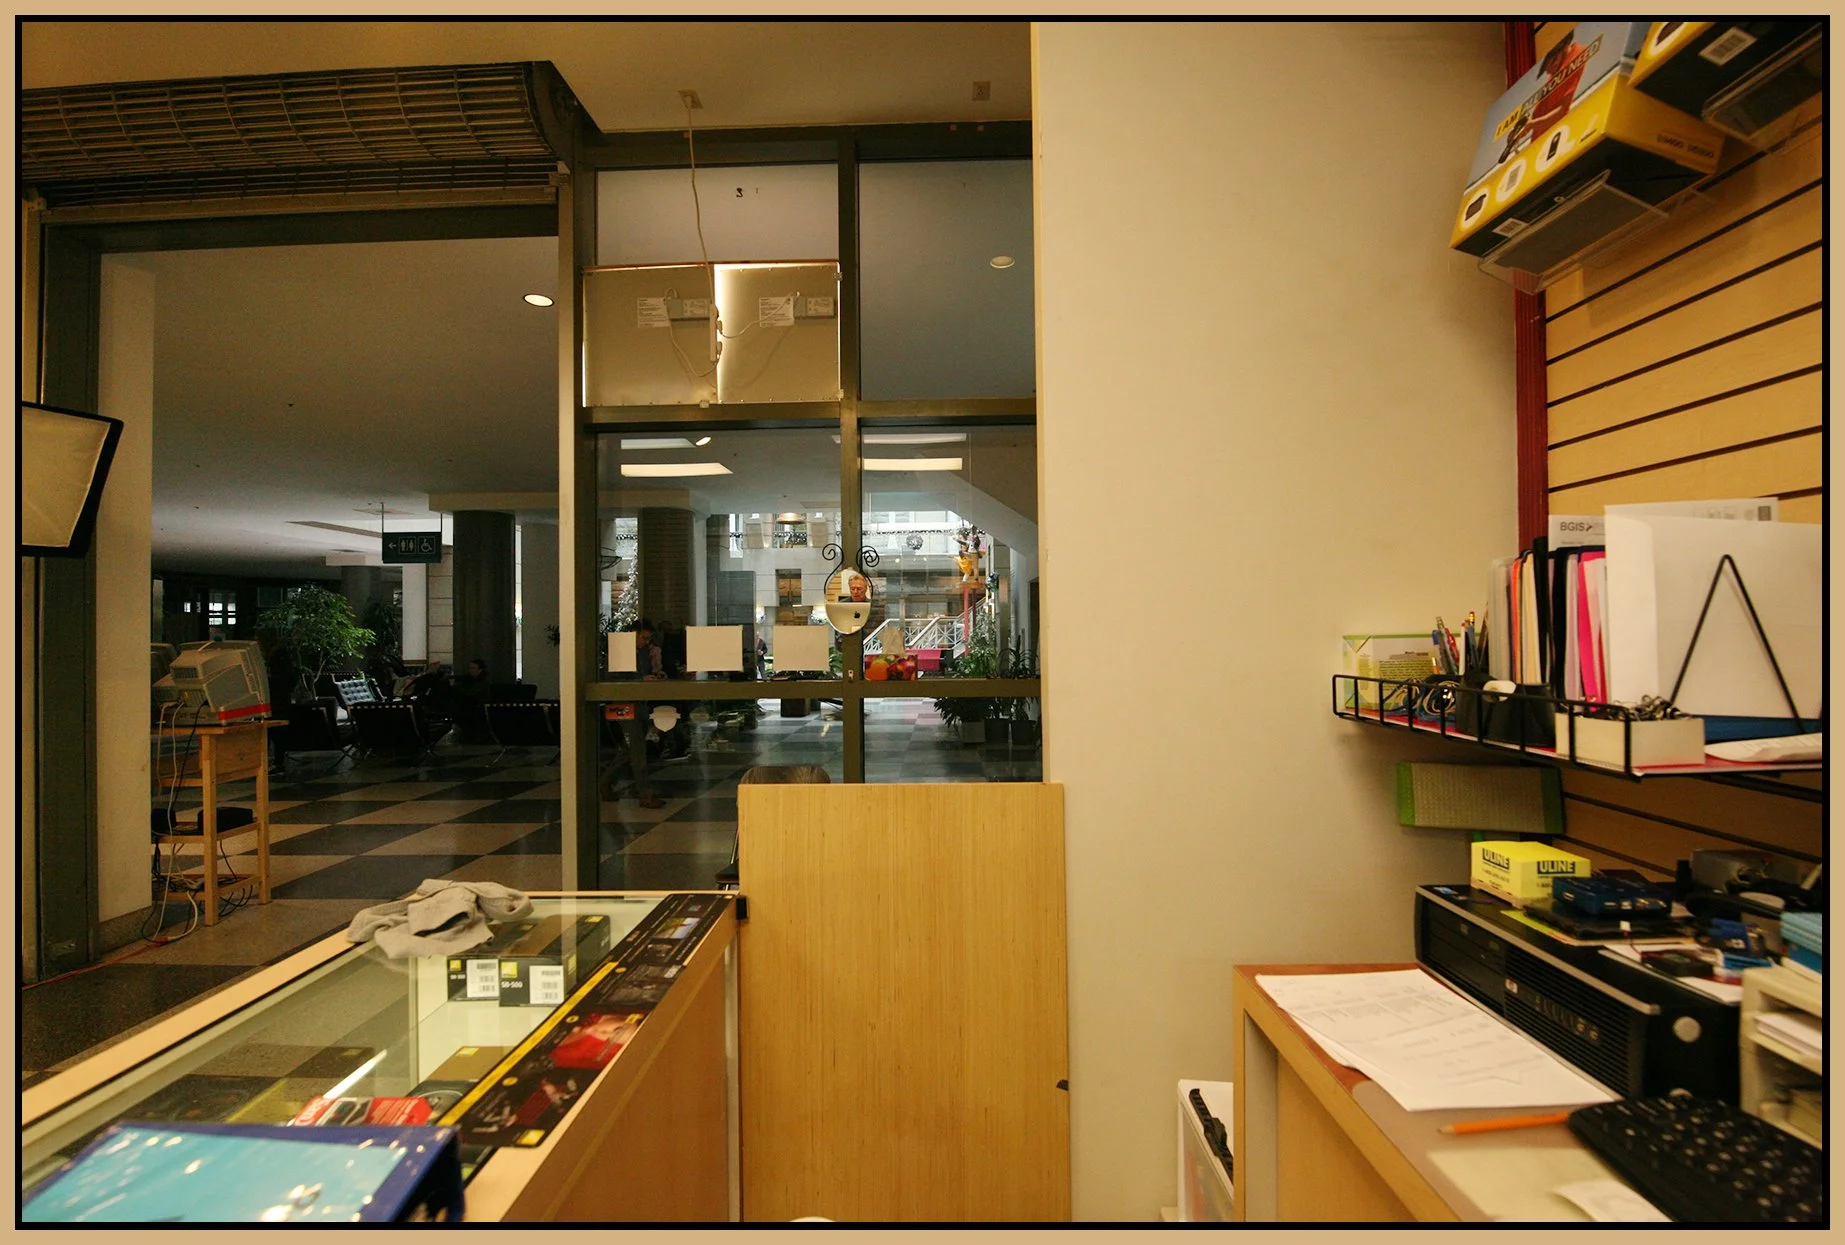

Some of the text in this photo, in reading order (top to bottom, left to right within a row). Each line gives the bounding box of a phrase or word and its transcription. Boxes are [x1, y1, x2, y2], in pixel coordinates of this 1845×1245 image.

[1502, 110, 1519, 131] AM
[1543, 68, 1568, 96] YOU
[1568, 40, 1599, 75] NEED
[1560, 521, 1585, 532] BGIS
[1483, 848, 1509, 869] ULINE
[1538, 860, 1575, 873] ULINE
